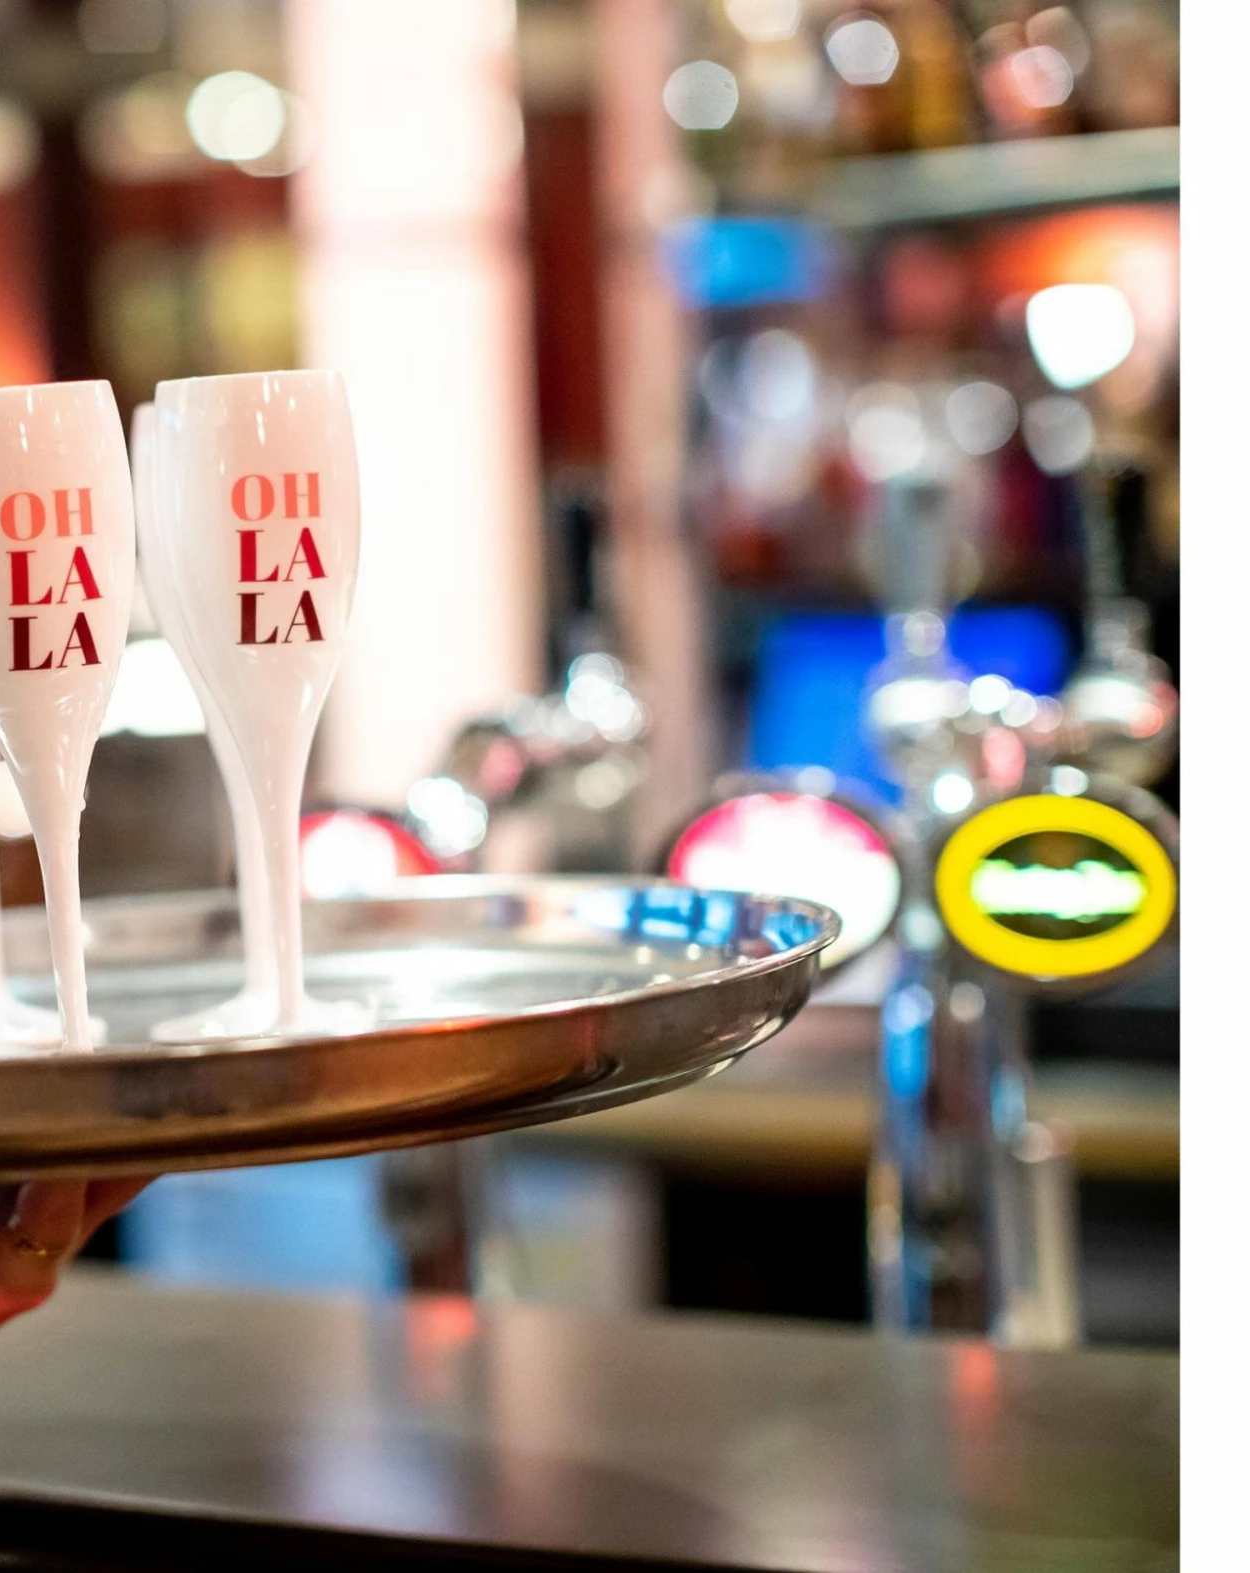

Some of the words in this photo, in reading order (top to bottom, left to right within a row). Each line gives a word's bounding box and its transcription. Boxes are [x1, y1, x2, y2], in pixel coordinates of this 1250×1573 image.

[0, 487, 96, 541] OH
[231, 472, 323, 522] OH
[6, 546, 103, 606] LA
[236, 527, 328, 583] LA
[8, 612, 102, 671] LA
[236, 590, 325, 645] LA
